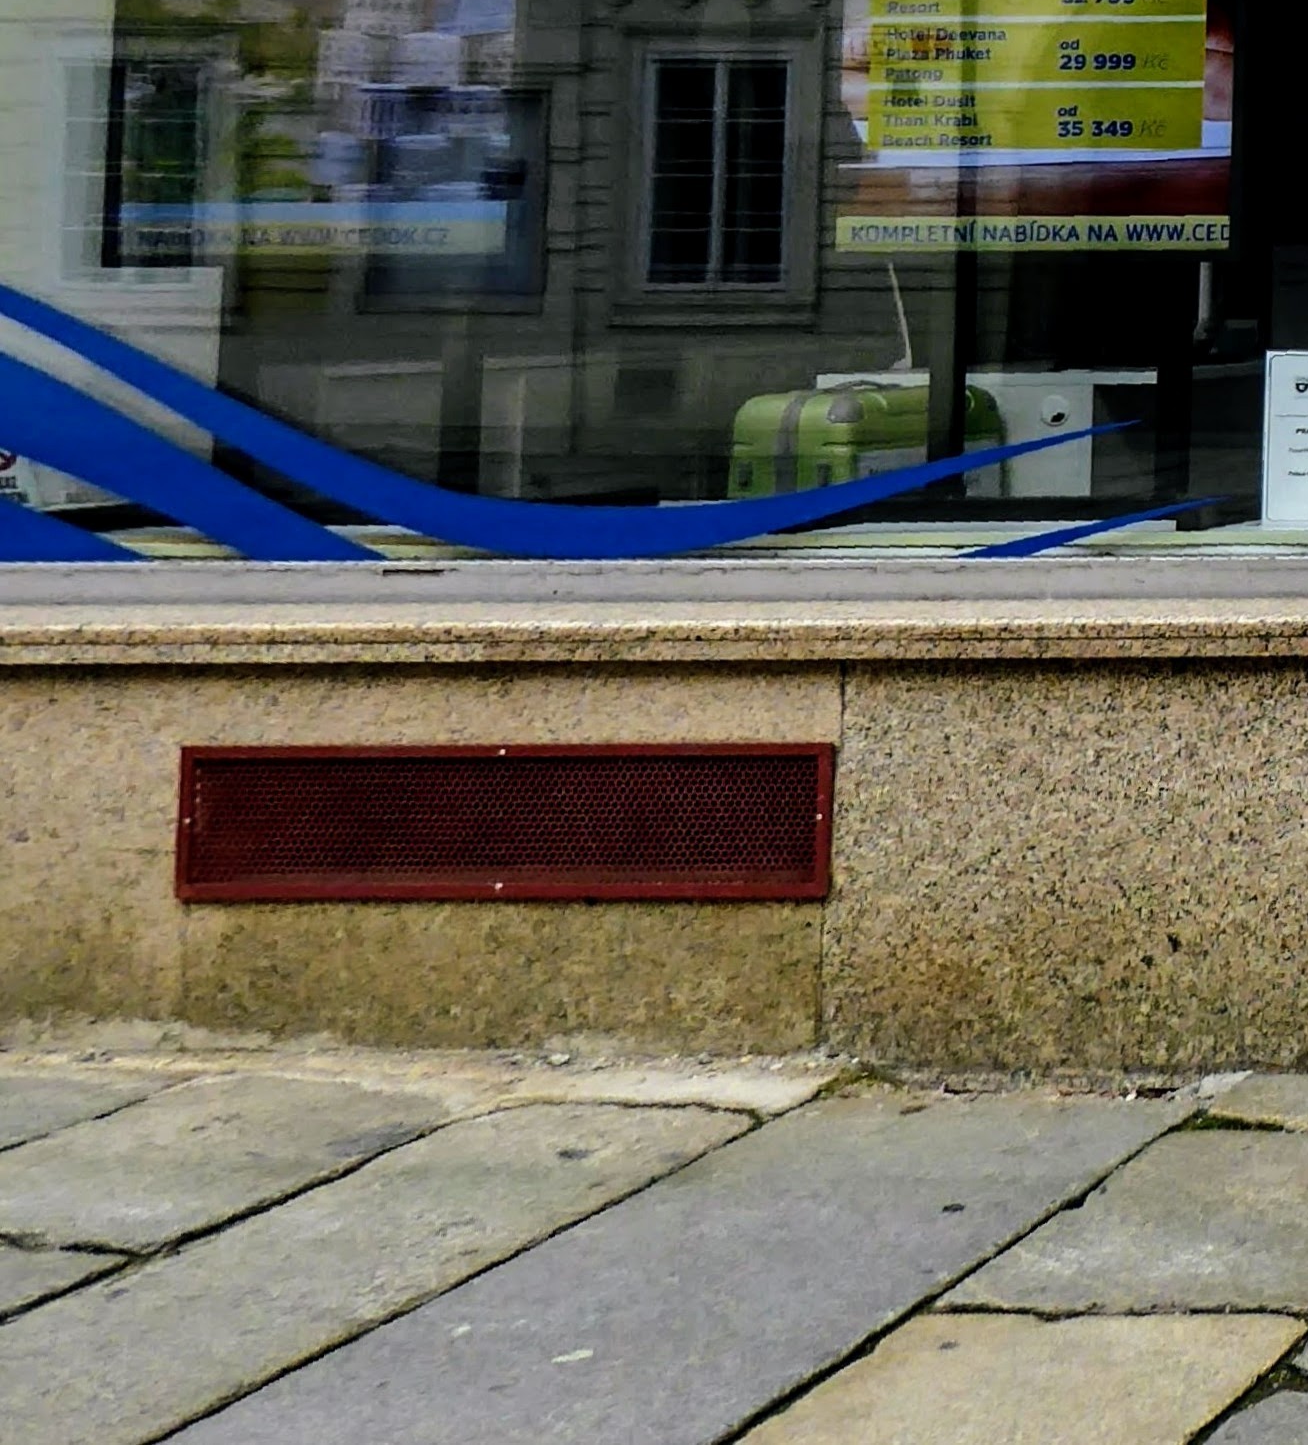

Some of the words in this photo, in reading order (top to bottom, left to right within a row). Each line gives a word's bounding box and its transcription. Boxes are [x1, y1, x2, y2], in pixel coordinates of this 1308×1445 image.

[887, 2, 940, 13] Resort
[888, 28, 931, 40] Hotel
[1059, 39, 1080, 50] od
[935, 47, 991, 60] Phuket
[1059, 54, 1087, 70] 29
[1093, 54, 1136, 70] 999
[884, 95, 928, 107] Hotel
[934, 95, 976, 107] Dusit
[1057, 106, 1078, 117] od
[934, 114, 978, 127] Krabi
[1058, 121, 1083, 137] 35
[1092, 121, 1133, 137] 349
[883, 135, 932, 146] Beach
[939, 134, 993, 146] Resort
[851, 219, 977, 243] KOMPLETNÍ
[983, 220, 1080, 243] NABÍDKA
[1087, 224, 1119, 242] NA
[1126, 223, 1230, 242] WWW.CED
